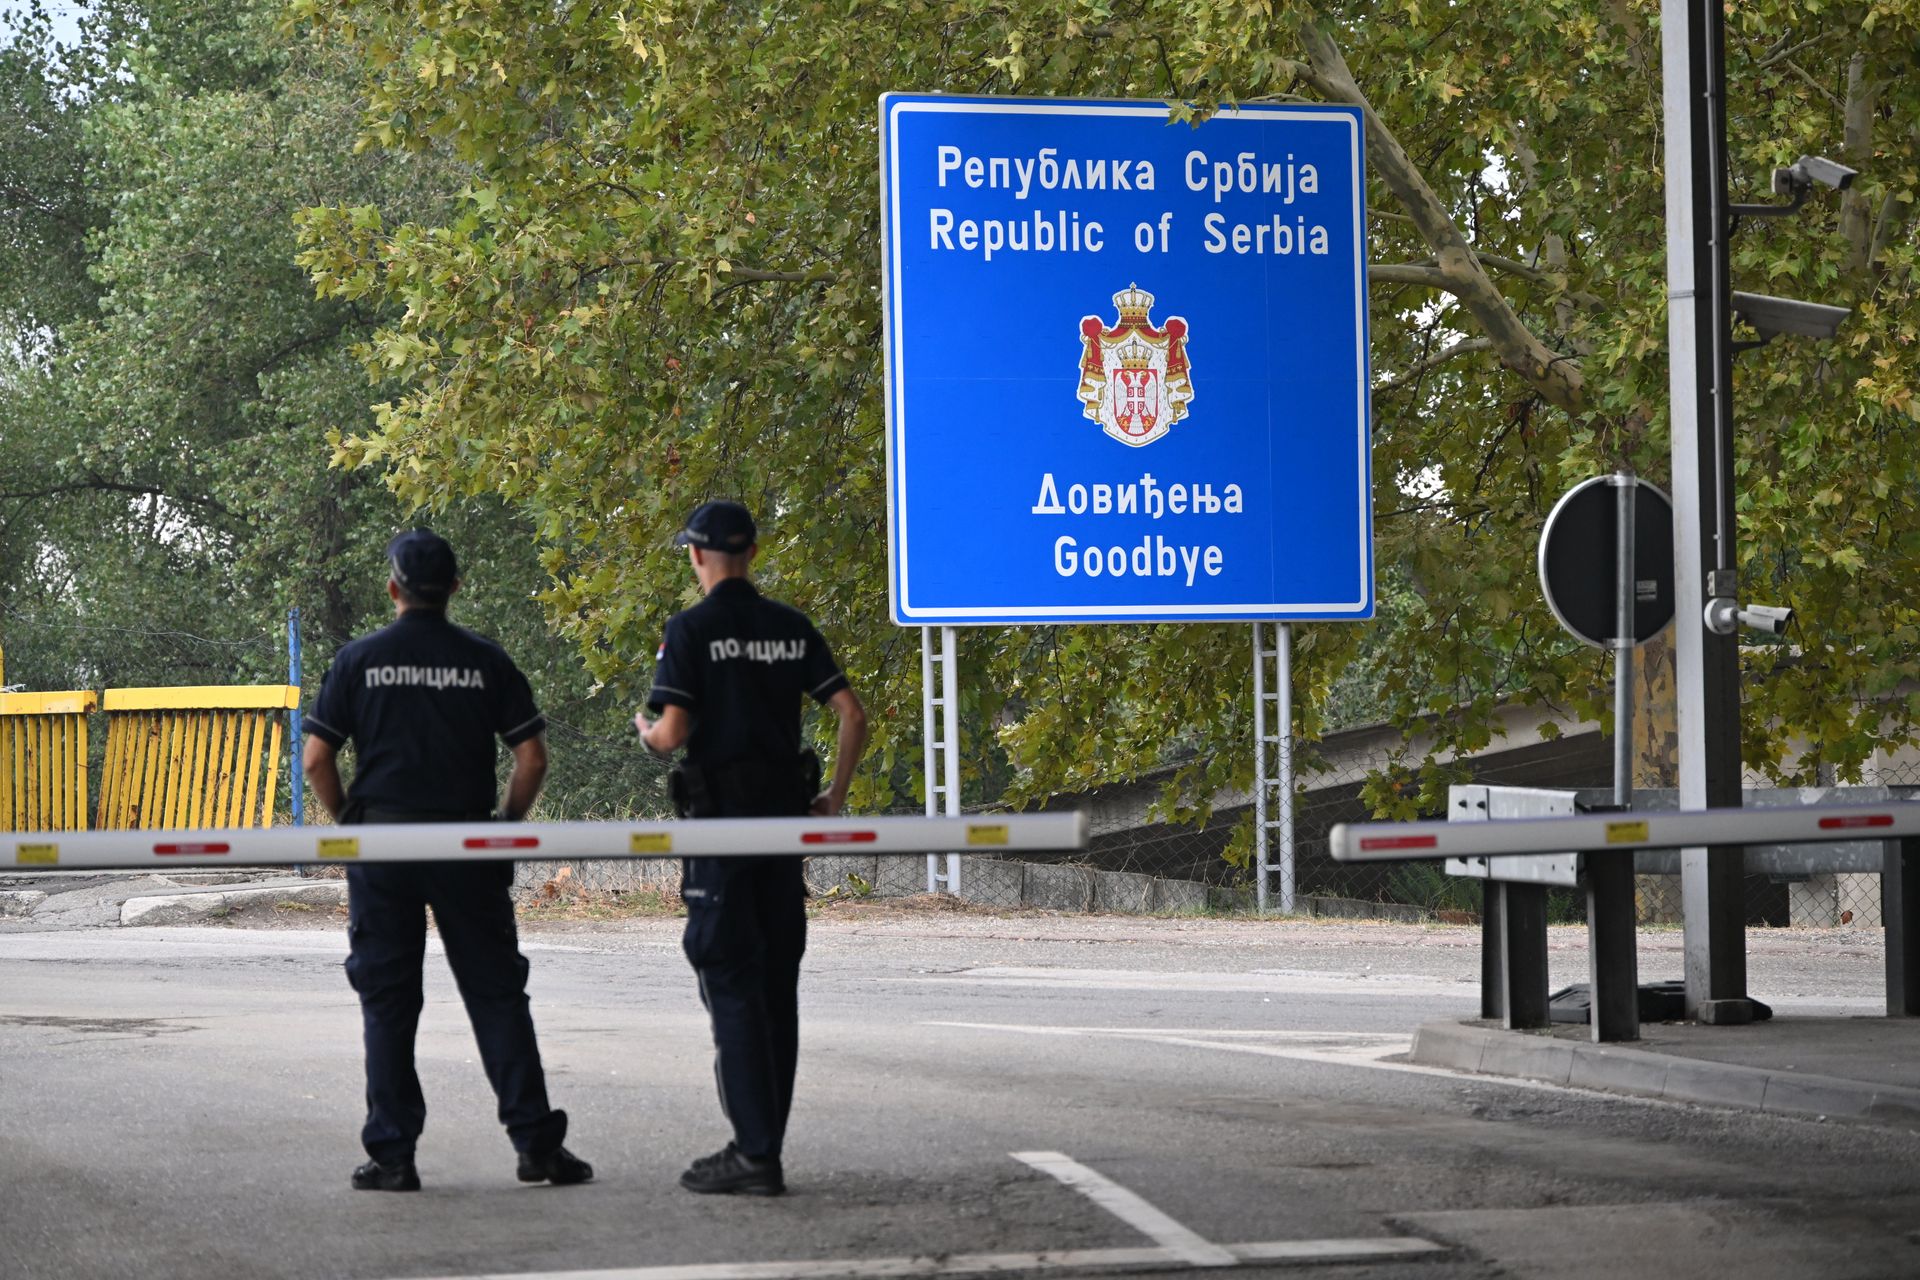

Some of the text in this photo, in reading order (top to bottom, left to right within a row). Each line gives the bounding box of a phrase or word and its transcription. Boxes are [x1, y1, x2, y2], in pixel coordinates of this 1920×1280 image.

[937, 145, 1318, 205] Република Србија
[930, 208, 1329, 262] Republic of Serbia
[1031, 472, 1243, 519] Довиђења
[1054, 535, 1223, 587] Goodbye
[364, 665, 485, 690] ПОЛИЦИЈА
